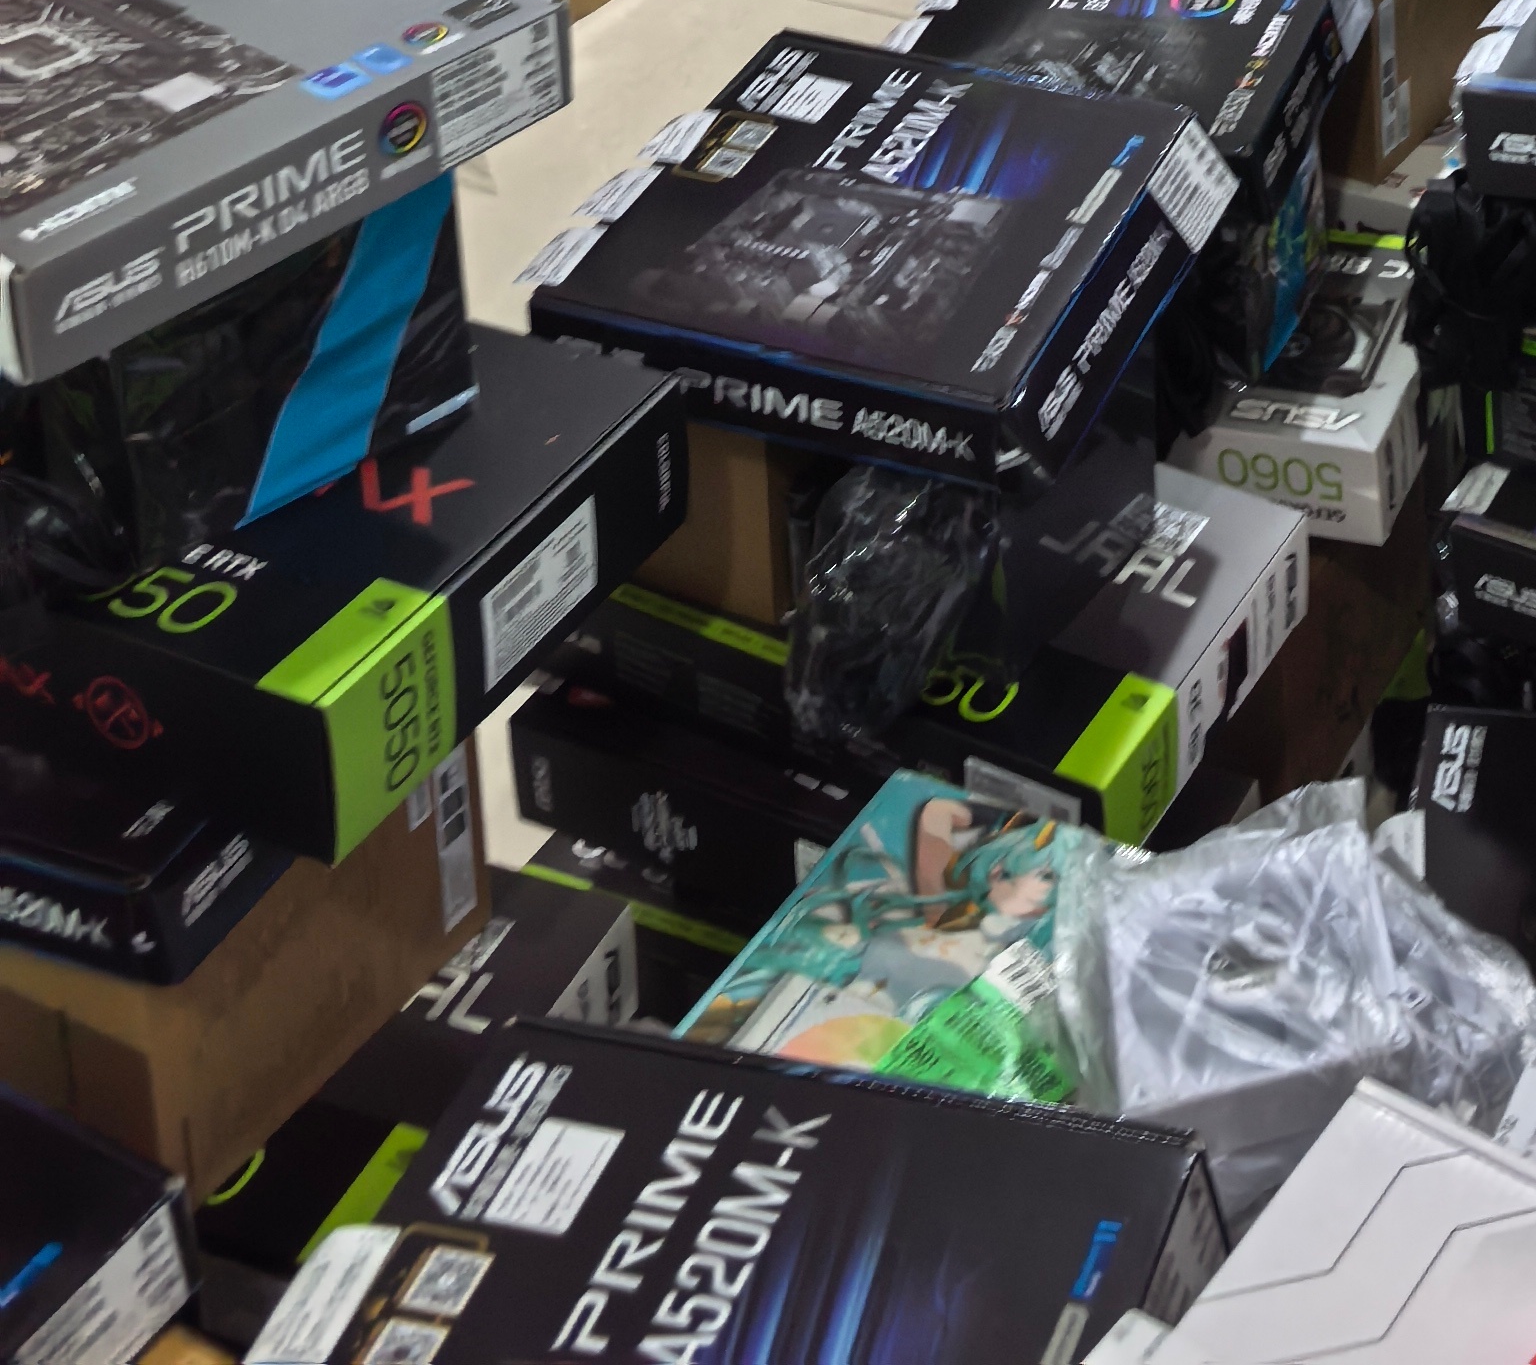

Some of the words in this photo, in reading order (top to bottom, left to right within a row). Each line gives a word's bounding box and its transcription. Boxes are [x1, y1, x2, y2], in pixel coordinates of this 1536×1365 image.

[170, 128, 367, 252] PRIME
[678, 369, 845, 434] PRIME
[1229, 397, 1362, 433] ASUS
[1216, 448, 1344, 502] 5060
[378, 650, 421, 794] 5050
[1430, 722, 1472, 813] ASUS
[550, 1088, 745, 1354] PRIME
[636, 1105, 832, 1365] A520M-K
